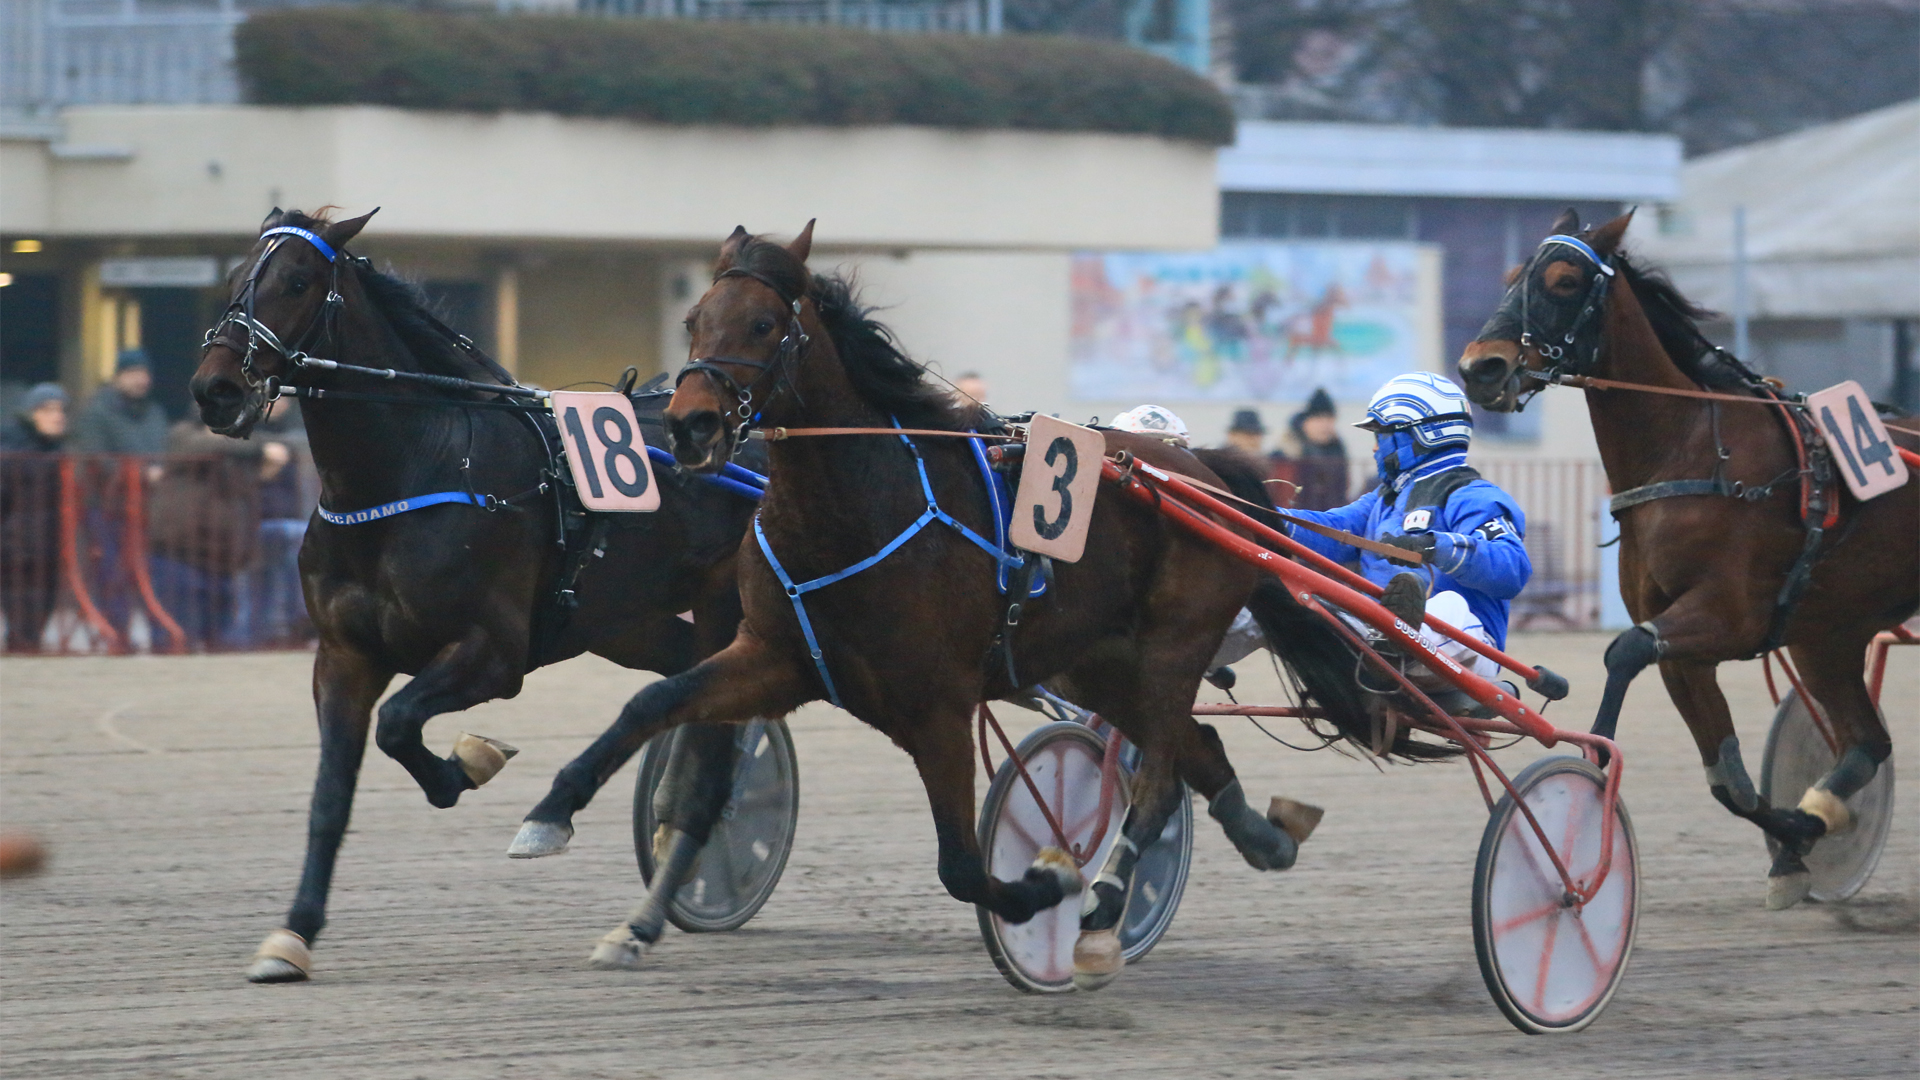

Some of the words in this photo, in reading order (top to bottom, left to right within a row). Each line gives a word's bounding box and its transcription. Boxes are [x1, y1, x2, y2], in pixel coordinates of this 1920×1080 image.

[261, 227, 314, 241] ADAMO
[563, 406, 649, 499] 18
[1820, 394, 1896, 488] 14
[1033, 436, 1078, 541] 3
